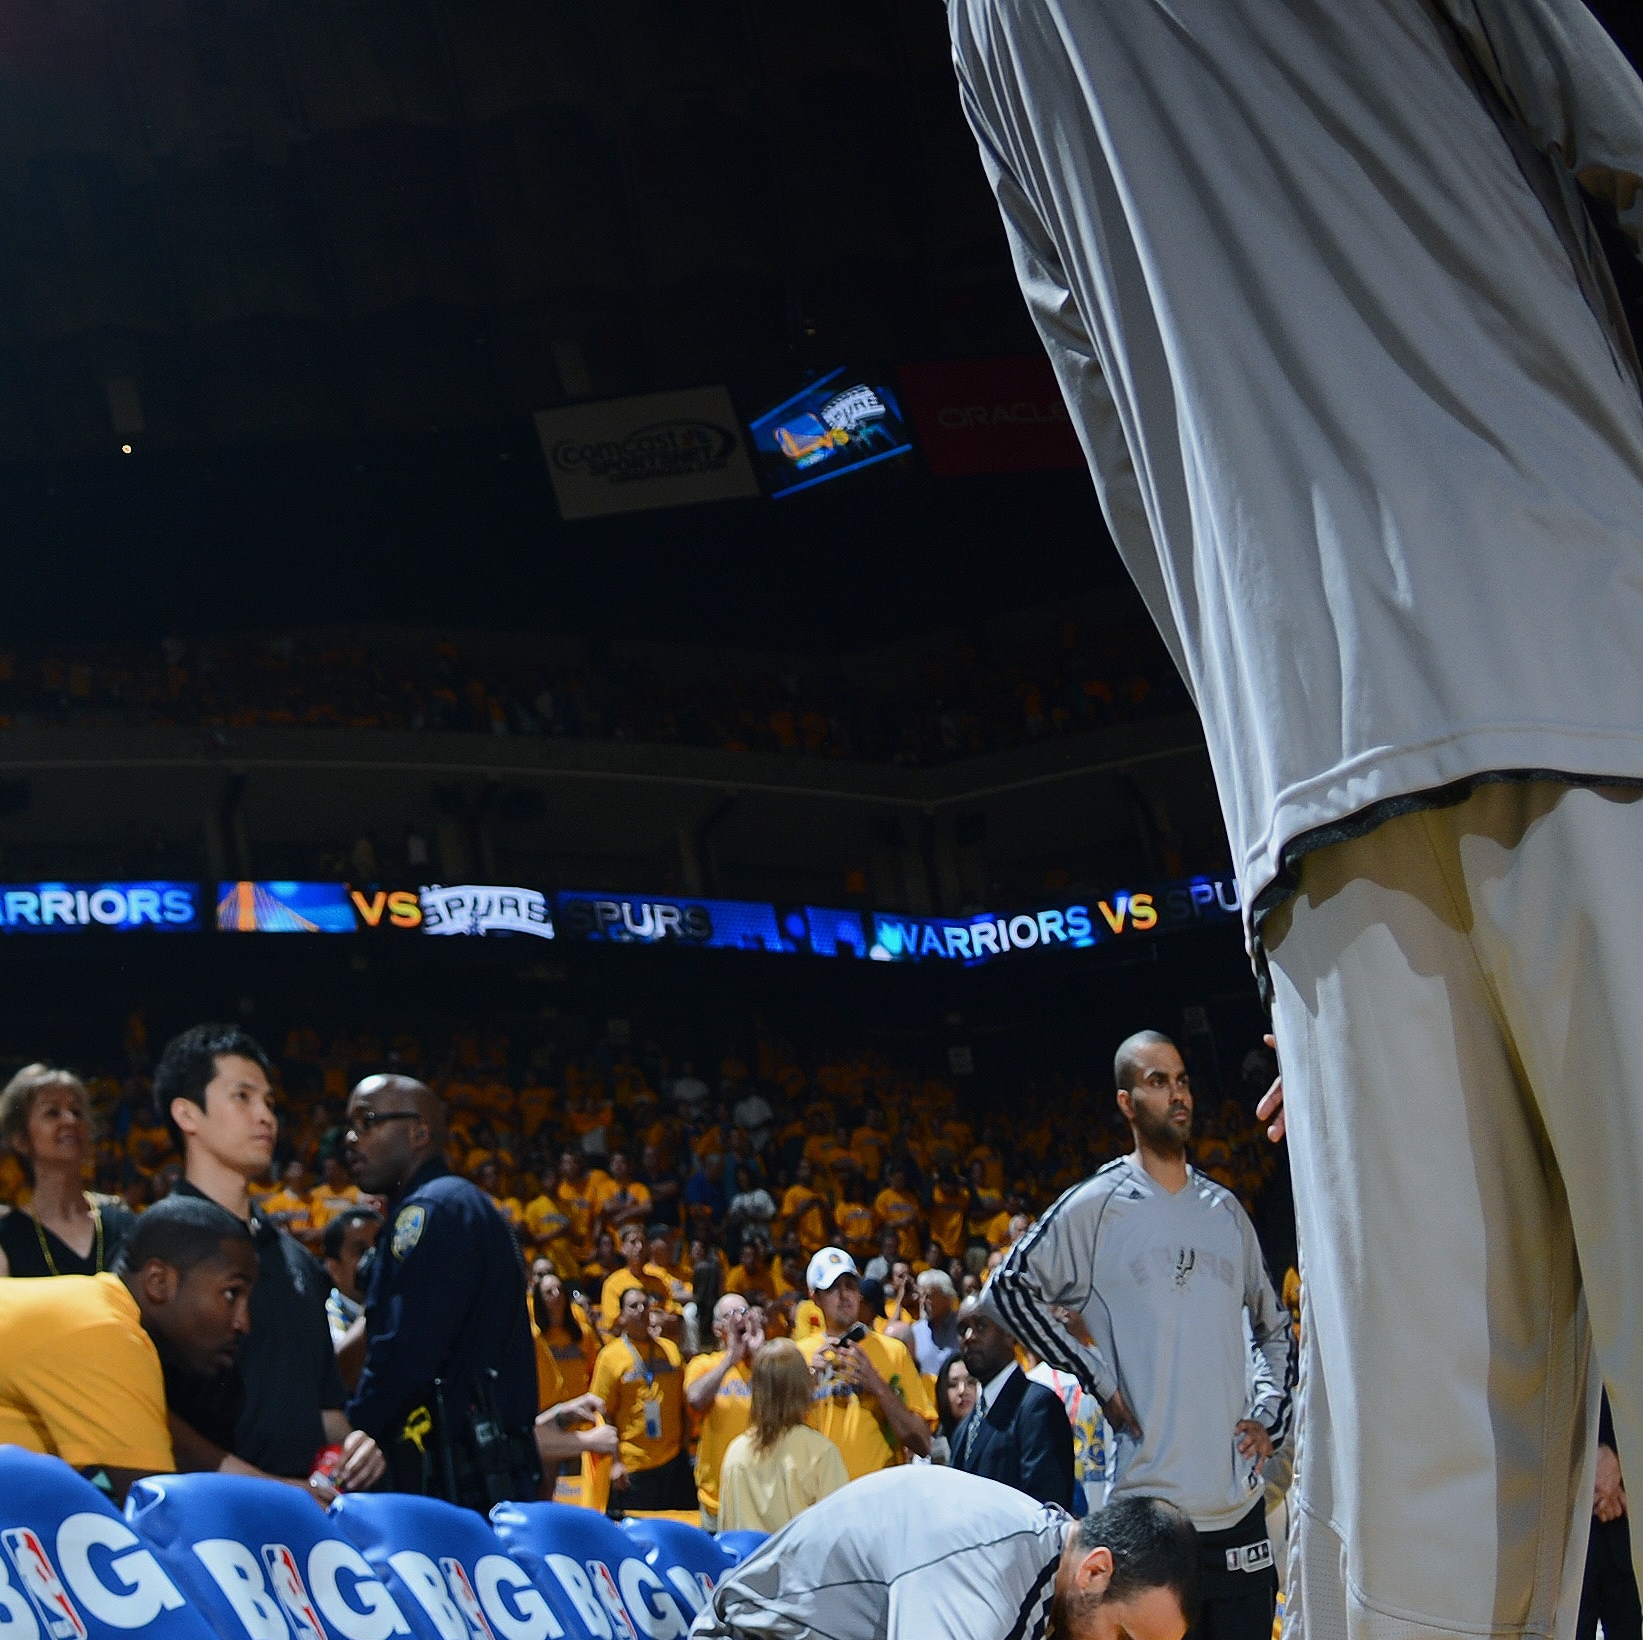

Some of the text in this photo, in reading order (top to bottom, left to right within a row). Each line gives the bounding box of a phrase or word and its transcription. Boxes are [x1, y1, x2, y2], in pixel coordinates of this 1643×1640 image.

[350, 890, 423, 928] VS
[570, 900, 713, 939] SPURS
[881, 905, 1093, 959] WARRIORS
[1097, 893, 1158, 934] VS
